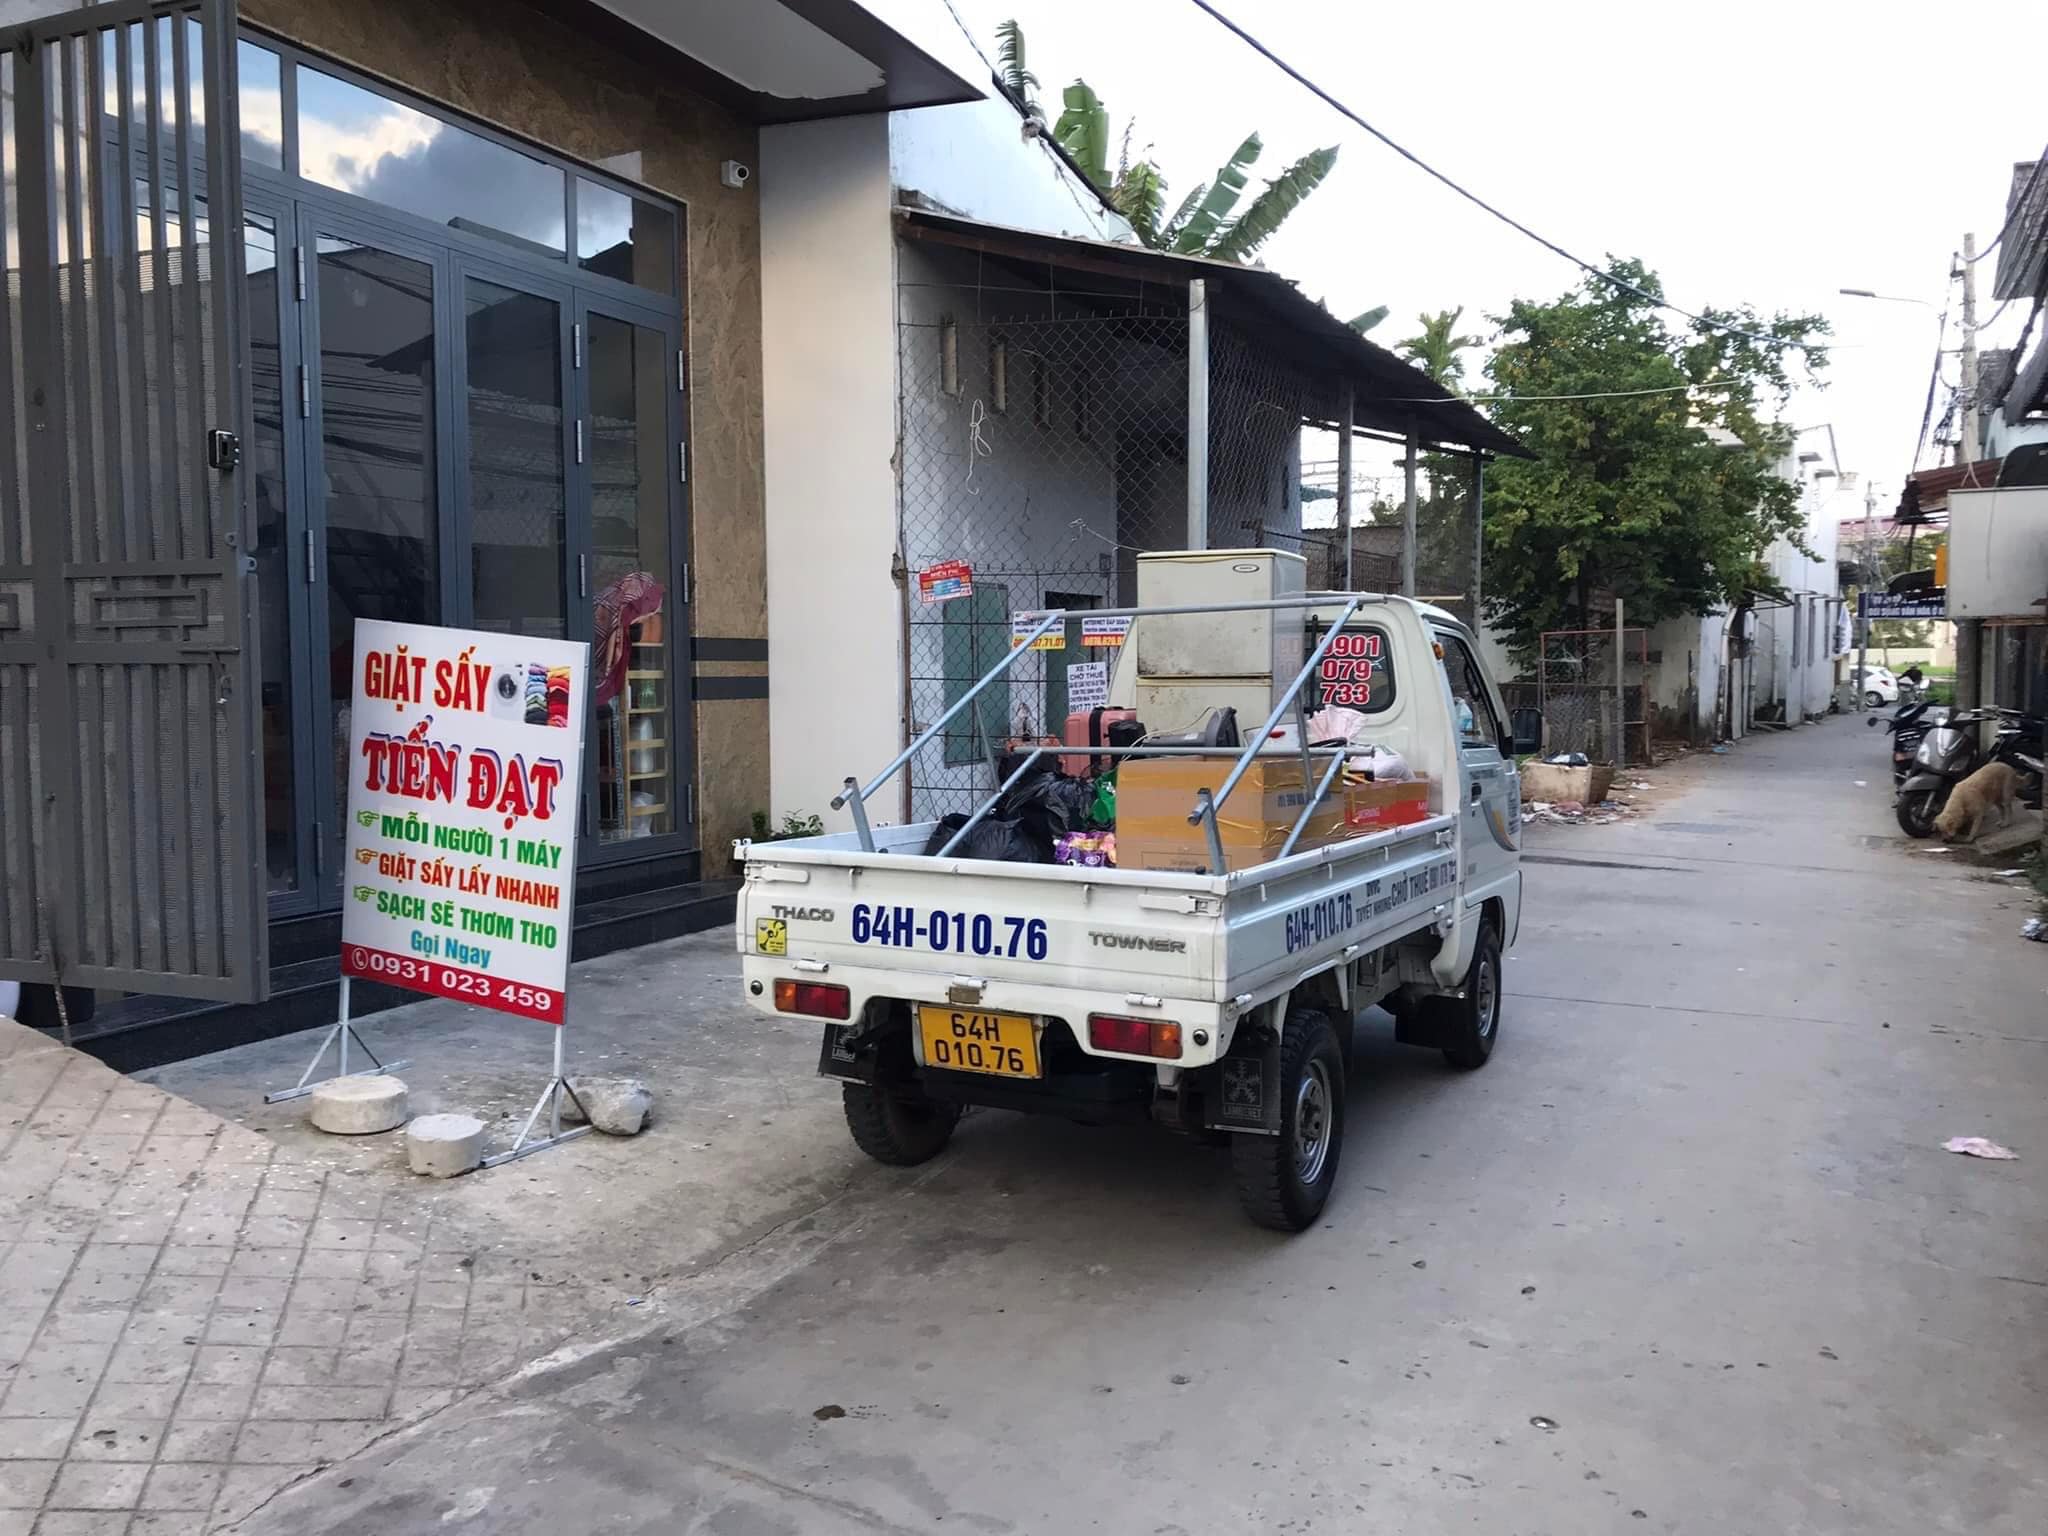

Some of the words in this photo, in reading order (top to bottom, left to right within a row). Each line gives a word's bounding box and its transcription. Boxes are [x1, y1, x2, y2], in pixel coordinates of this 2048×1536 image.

[364, 643, 427, 713] GIẶT
[433, 645, 492, 713] SẤY
[1320, 682, 1370, 705] 733
[1321, 658, 1372, 681] 079
[466, 747, 563, 831] ĐẠT
[381, 811, 429, 845] MỖI
[433, 826, 494, 858] NGƯỜI
[499, 836, 508, 861] 1
[516, 838, 562, 870] MÁY
[378, 849, 417, 884] GIẶT
[420, 856, 455, 889] SẤY
[458, 863, 492, 896] LẤY
[494, 874, 560, 910] NHANH
[376, 889, 425, 921] SẠCH
[460, 906, 514, 940] THƠM
[519, 919, 558, 950] THO
[771, 904, 835, 923] THACO
[851, 902, 1049, 962] 64H-010.76
[1087, 930, 1187, 955] TOWNER
[1285, 891, 1353, 955] 64H-010.76
[411, 928, 440, 959] Gọi
[444, 935, 492, 969] Ngay
[369, 953, 430, 984] 0931
[441, 969, 491, 997] 023
[499, 983, 552, 1012] 459
[934, 1038, 1025, 1073] 010.76
[951, 1012, 1002, 1043] 64H
